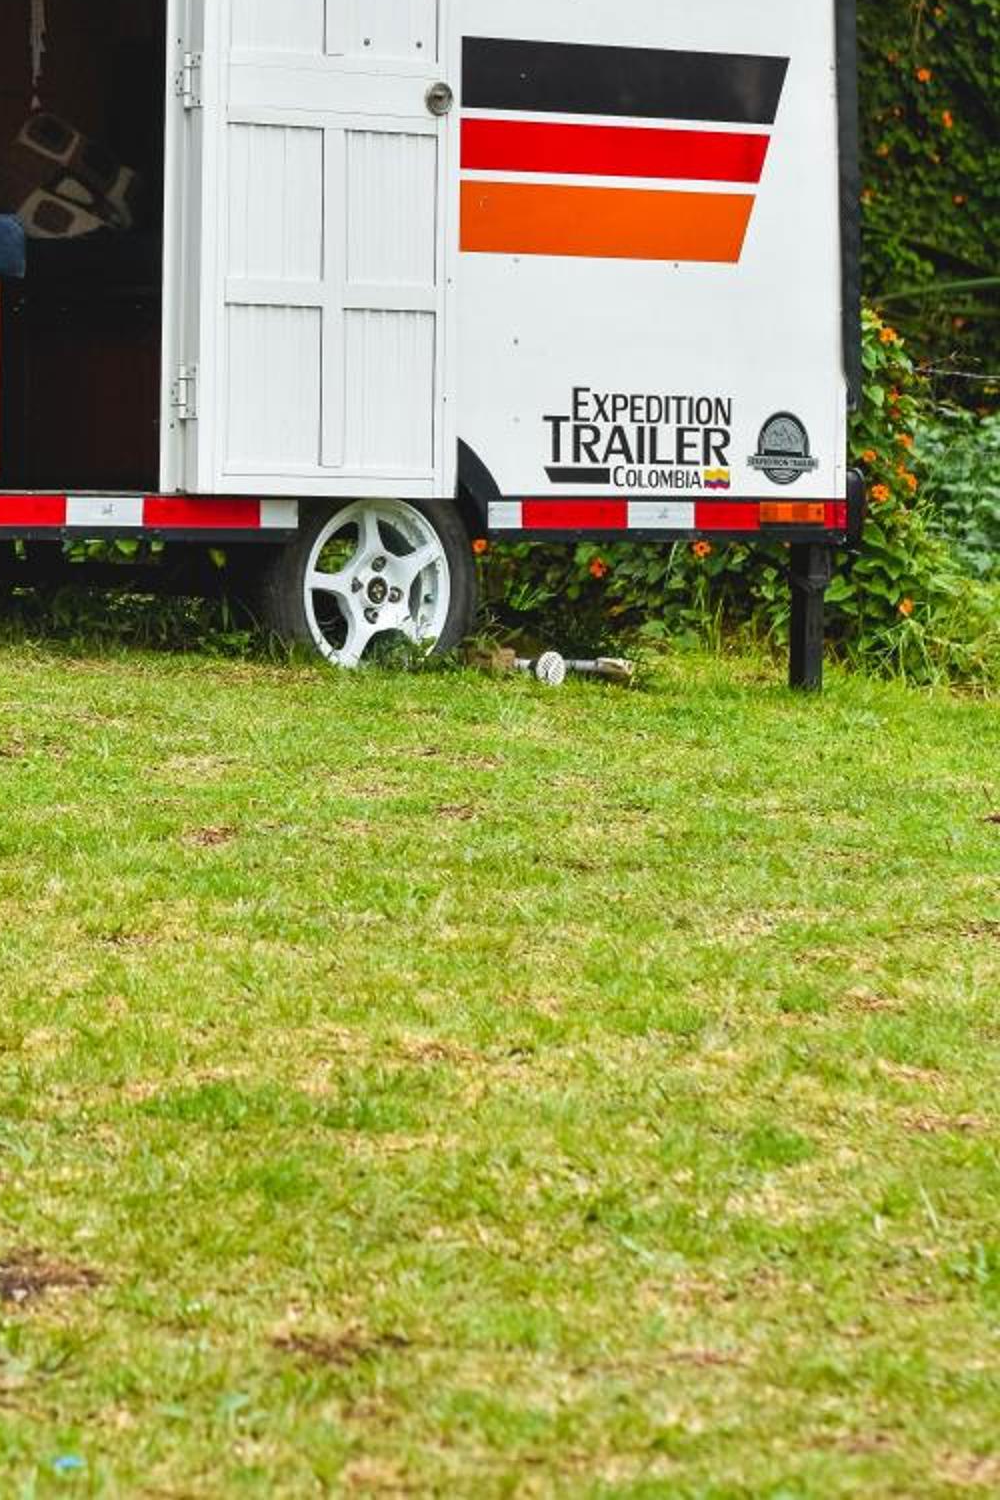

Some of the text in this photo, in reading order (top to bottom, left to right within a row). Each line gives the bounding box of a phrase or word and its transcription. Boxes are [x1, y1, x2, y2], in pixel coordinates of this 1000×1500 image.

[571, 386, 732, 426] EXPEDITION
[542, 414, 732, 467] TRAILER
[612, 465, 703, 490] COLOMBIA
